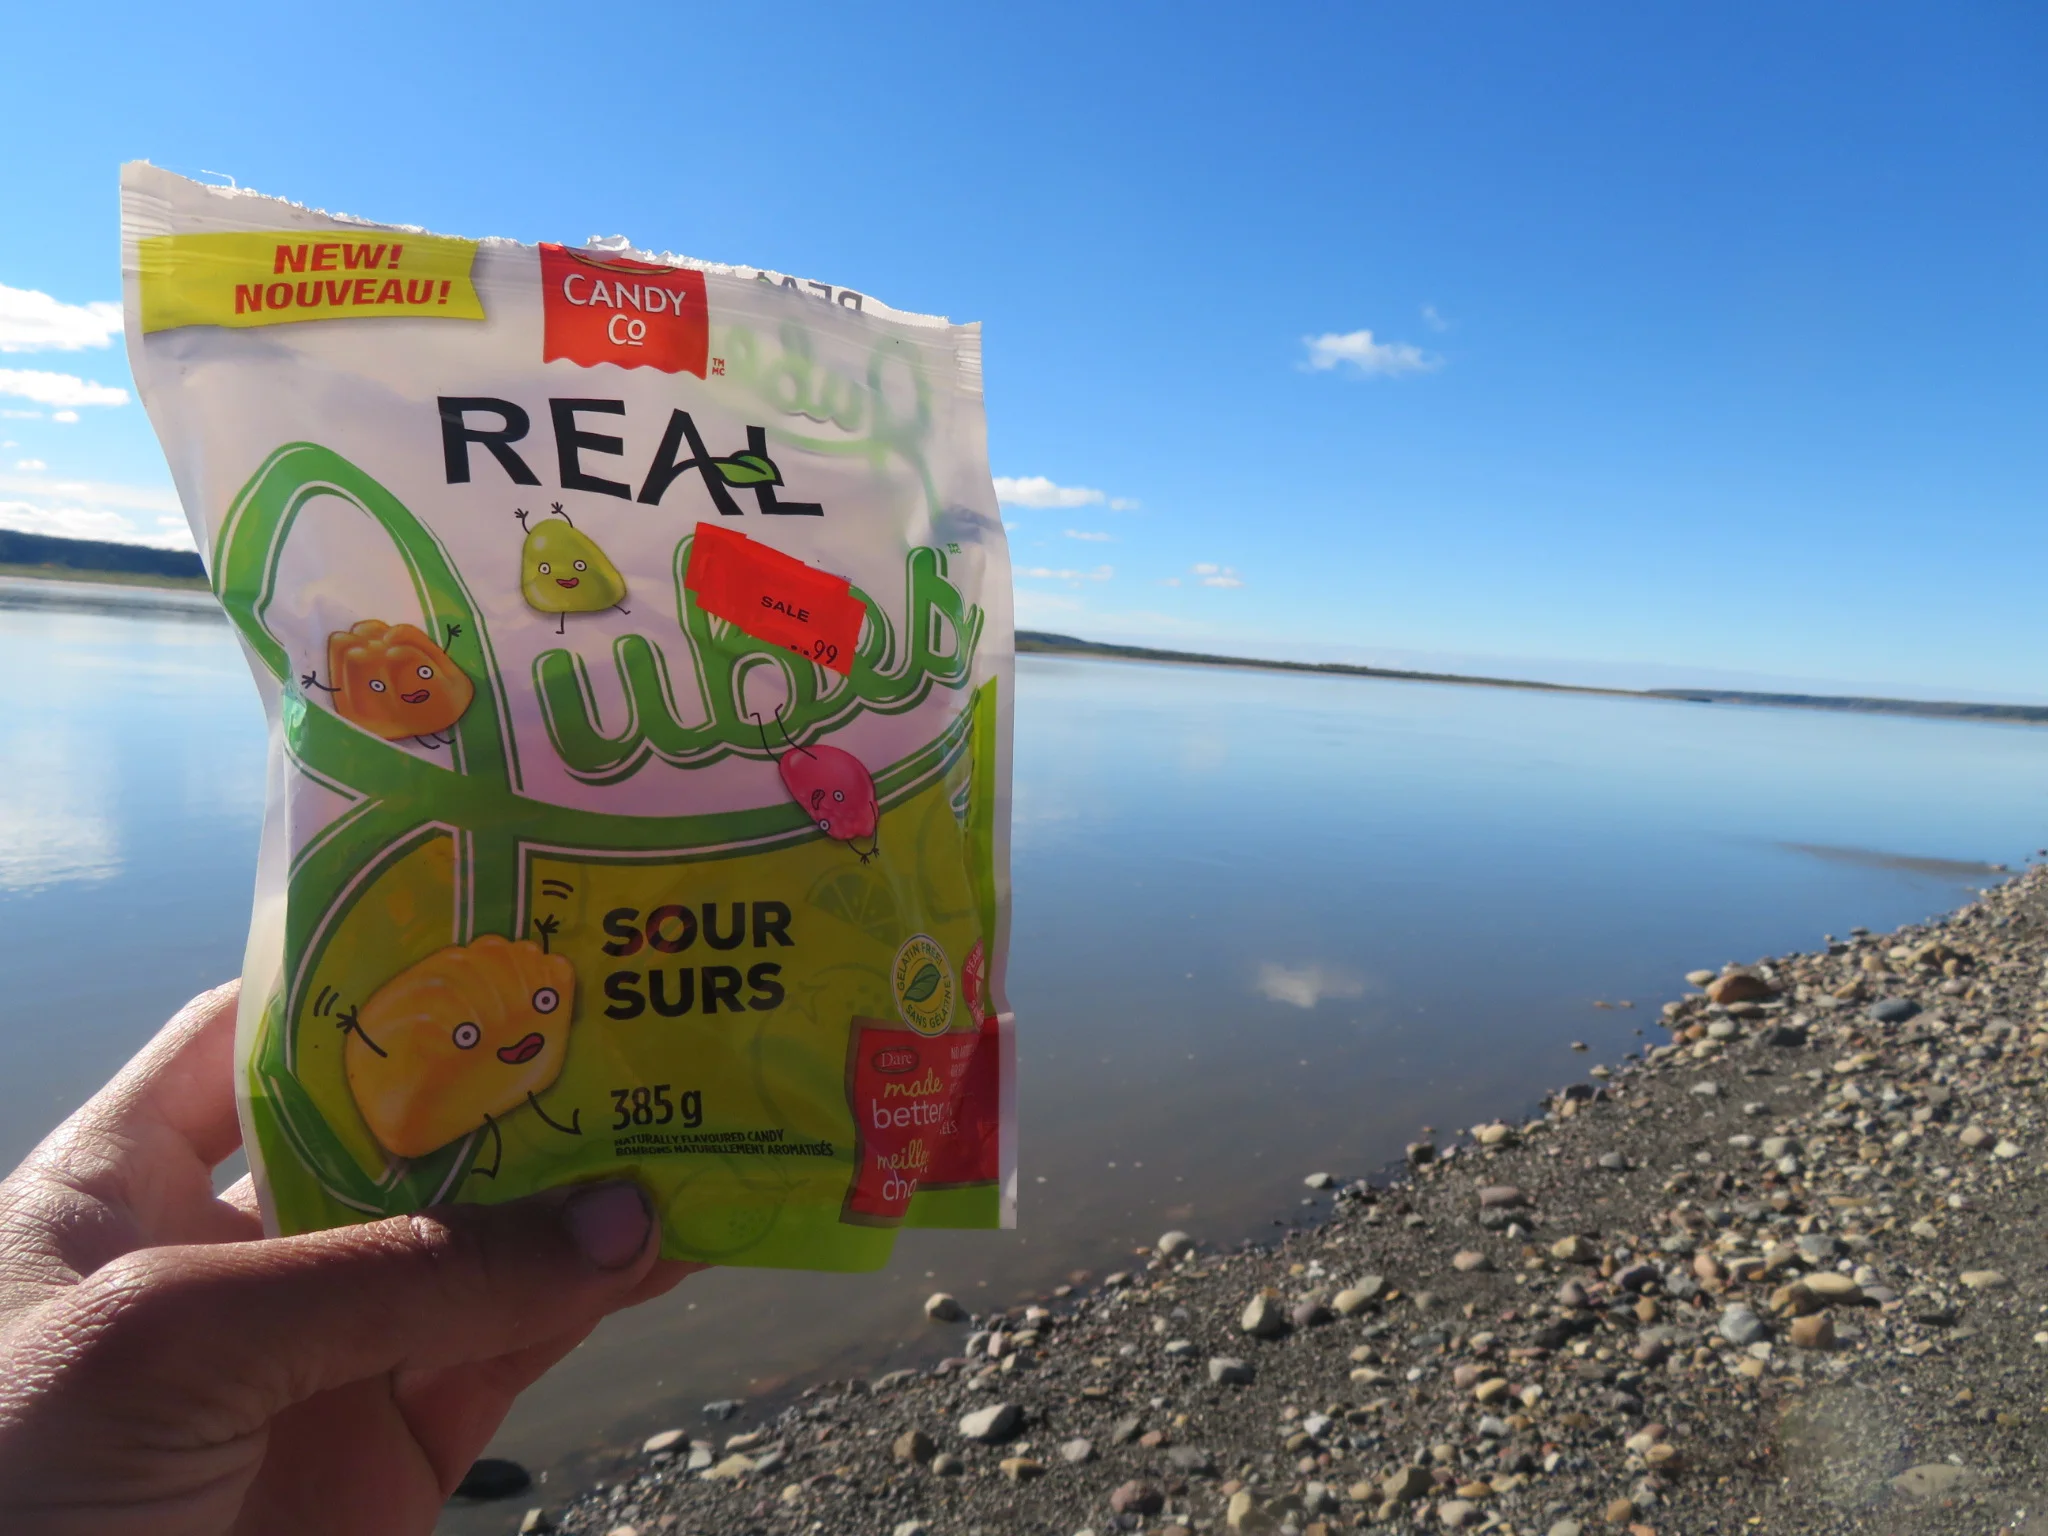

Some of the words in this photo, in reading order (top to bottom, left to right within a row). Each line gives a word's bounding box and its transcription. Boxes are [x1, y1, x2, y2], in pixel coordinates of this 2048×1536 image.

[273, 243, 404, 275] NEW!
[234, 279, 451, 314] NOUVEAU!
[563, 274, 687, 317] CANDY
[437, 395, 824, 517] REAL
[760, 595, 810, 623] SALE
[601, 900, 796, 957] SOUR
[897, 943, 921, 991] GELATIN
[603, 962, 786, 1021] SURS
[905, 1004, 927, 1029] SANS
[881, 1053, 913, 1067] Dare
[883, 1067, 944, 1099] made
[610, 1084, 674, 1131] 385
[680, 1089, 703, 1129] g
[872, 1098, 944, 1129] better
[614, 1133, 680, 1147] NATURALLY
[681, 1131, 746, 1144] FLAVOURED
[747, 1129, 785, 1143] CANDY
